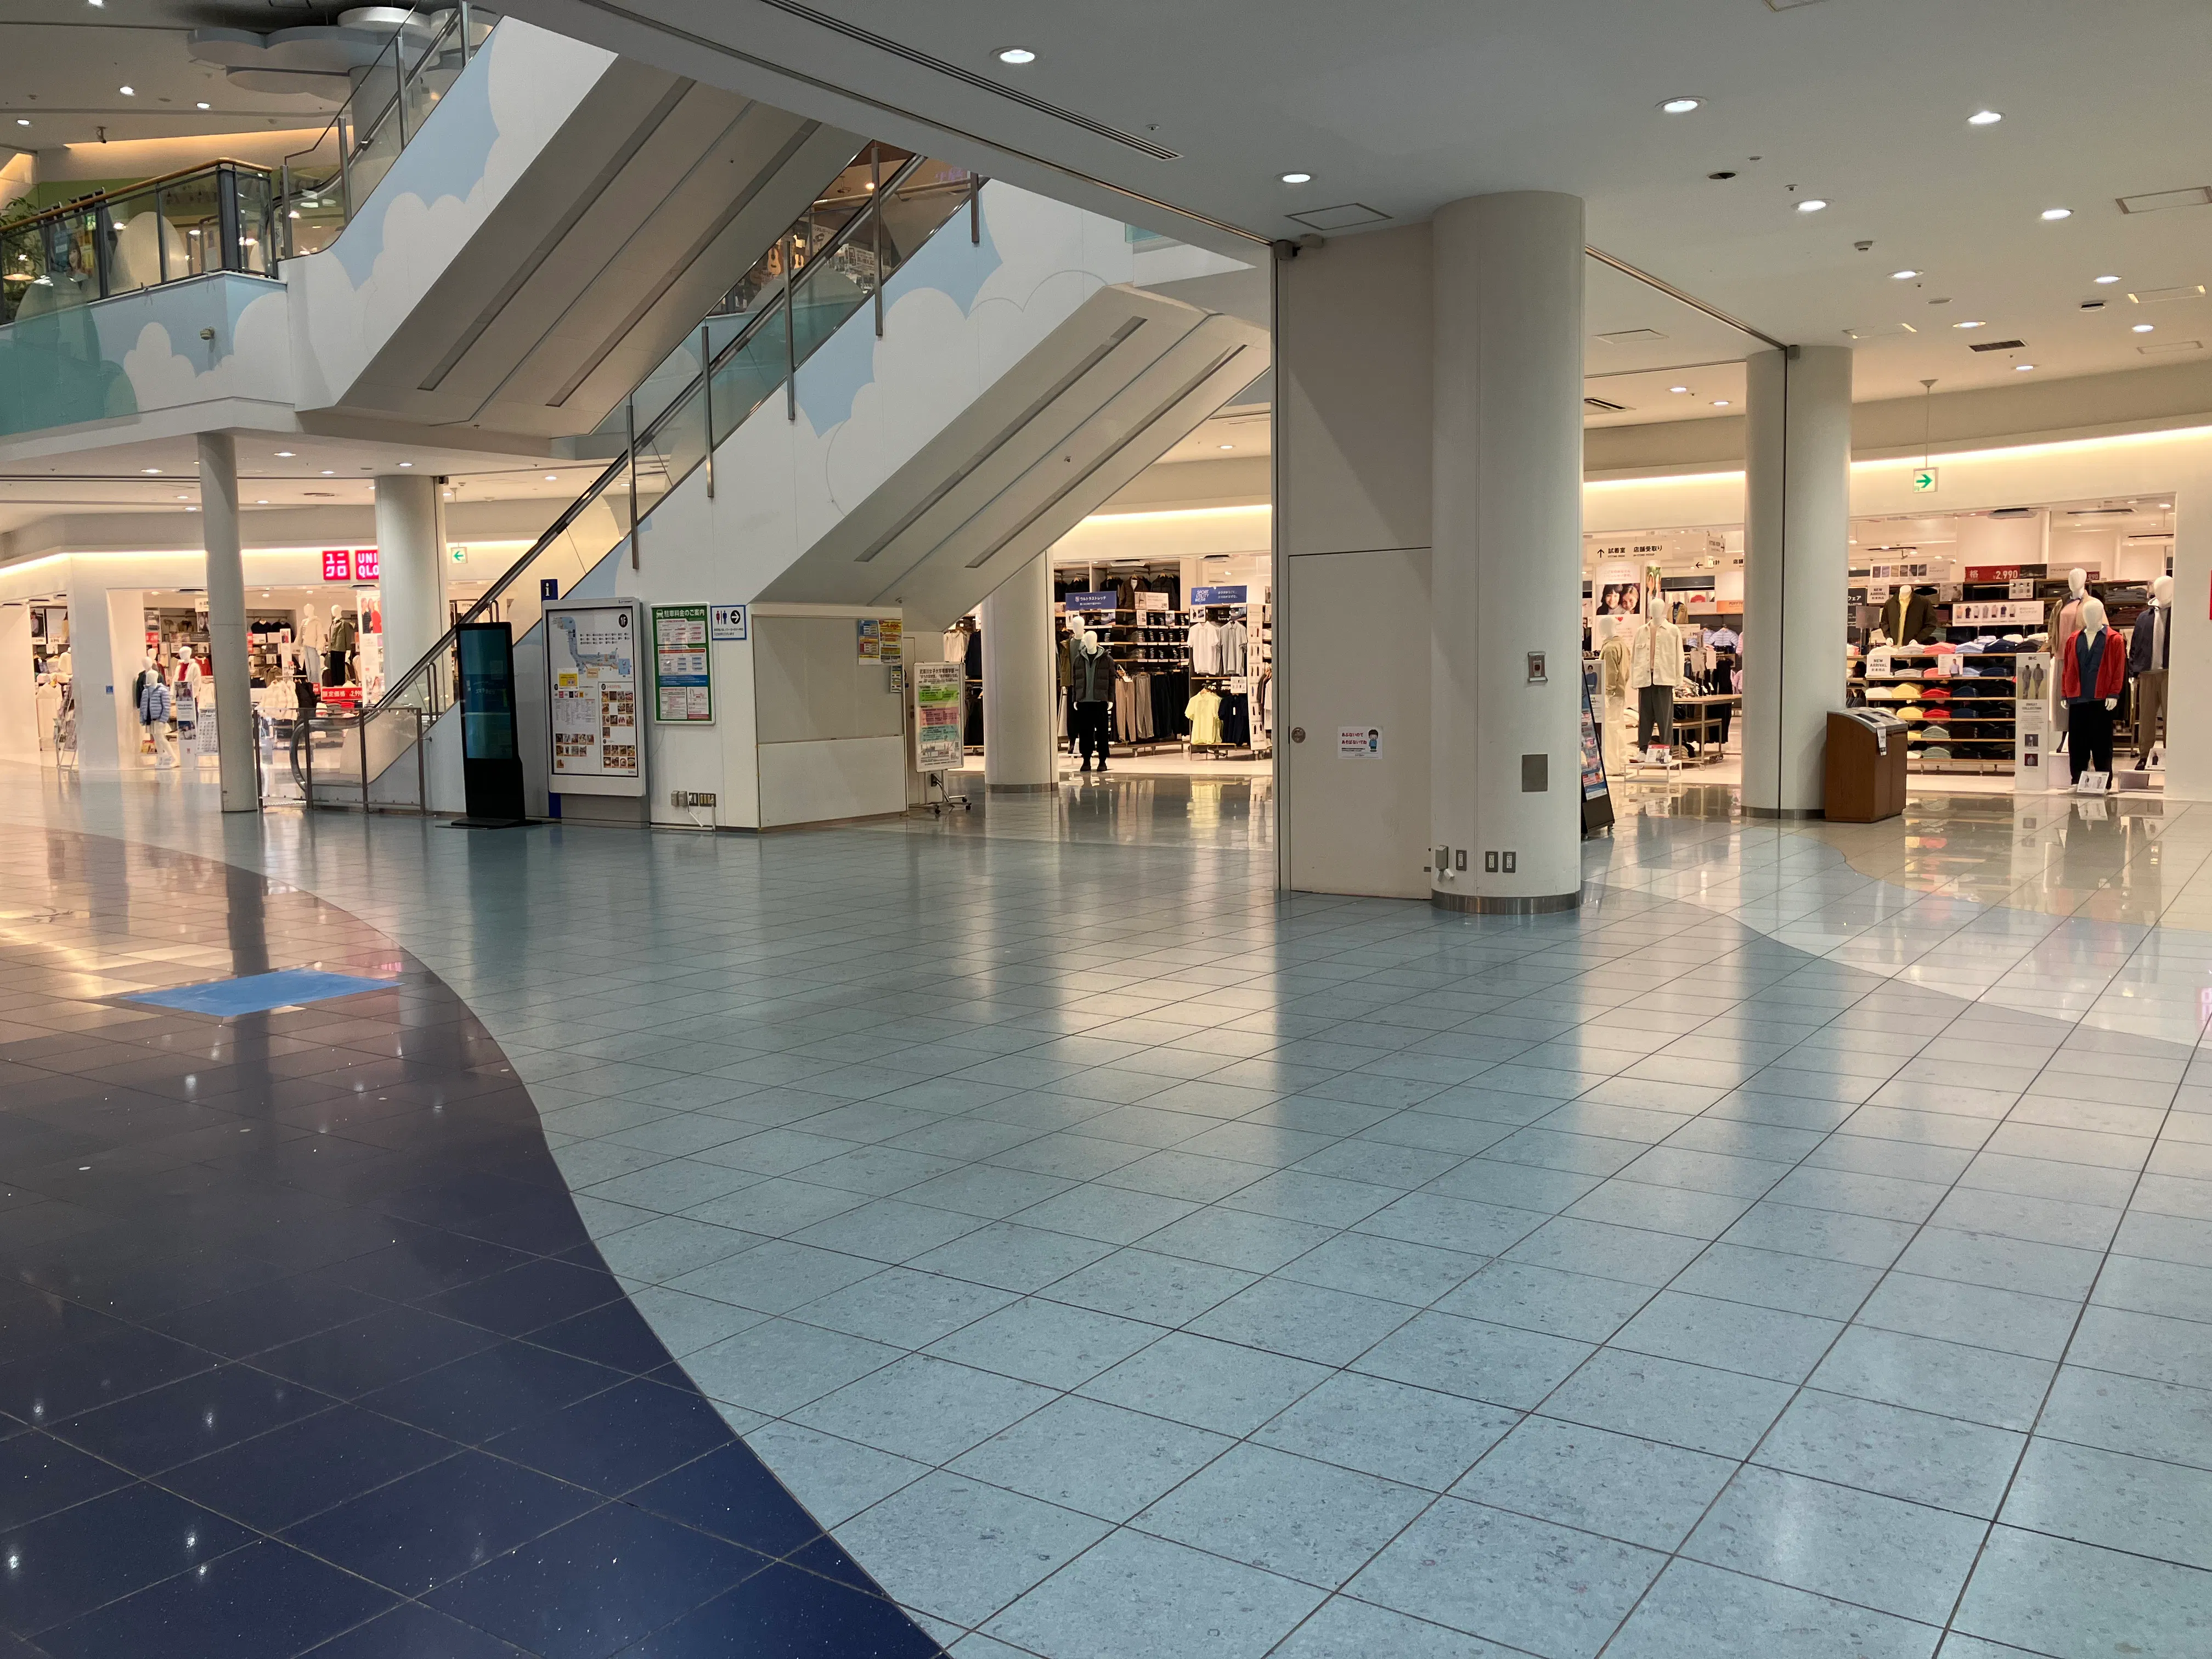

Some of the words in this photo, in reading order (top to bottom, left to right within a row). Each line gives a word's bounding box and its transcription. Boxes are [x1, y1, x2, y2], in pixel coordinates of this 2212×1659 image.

[358, 552, 376, 563] UNI
[358, 565, 379, 578] QLO
[664, 609, 705, 617] 駐車料金のご案内
[620, 617, 627, 625] 1F
